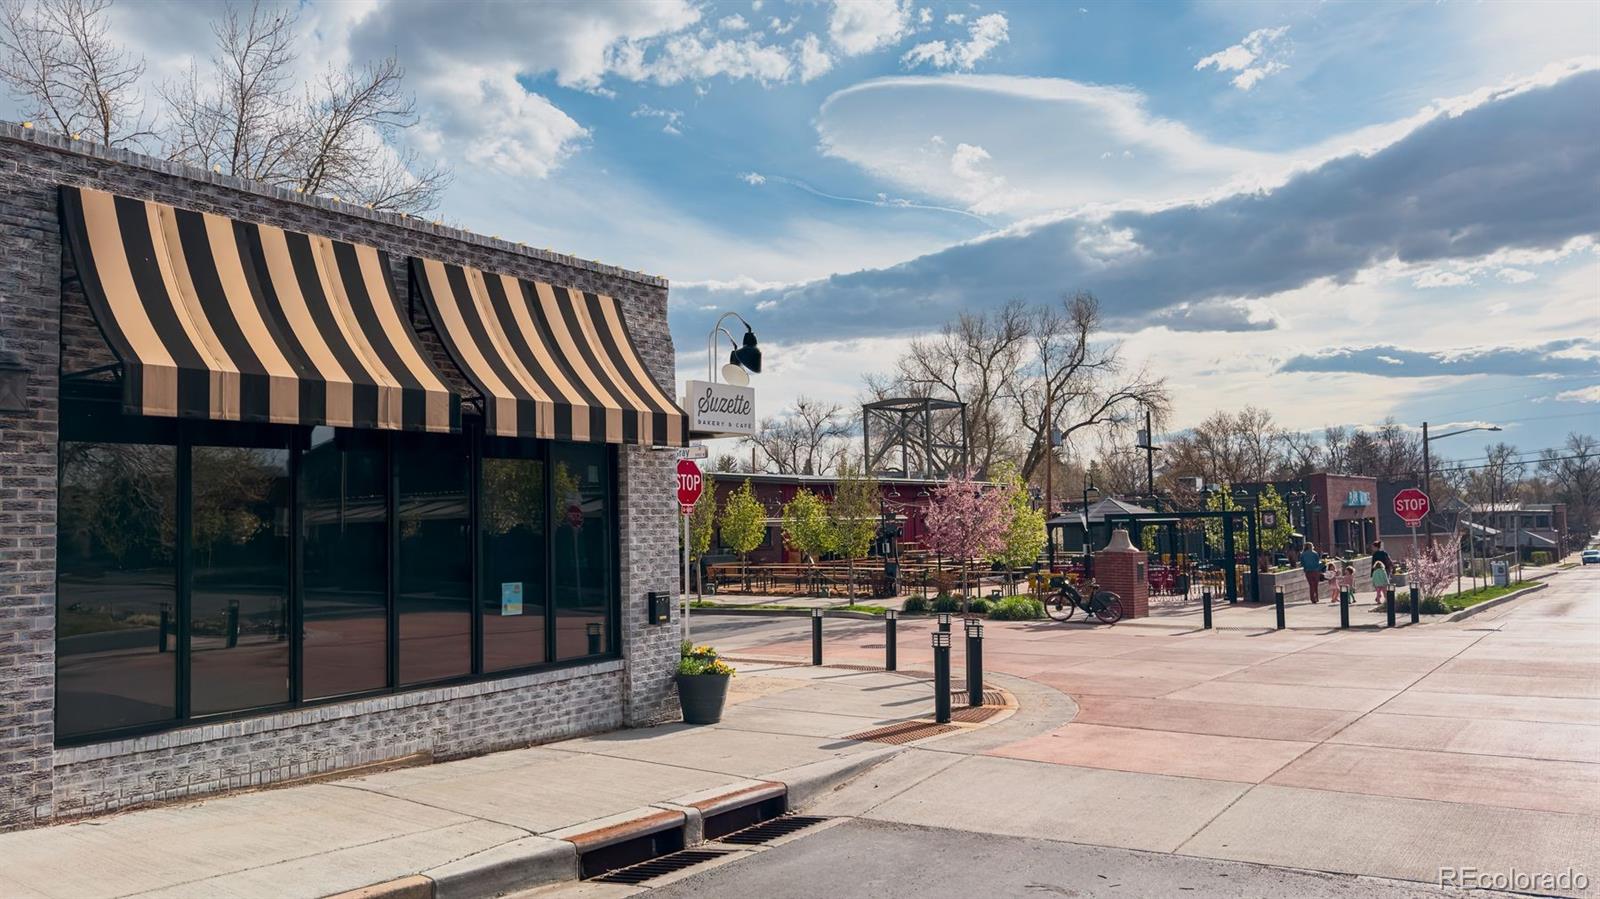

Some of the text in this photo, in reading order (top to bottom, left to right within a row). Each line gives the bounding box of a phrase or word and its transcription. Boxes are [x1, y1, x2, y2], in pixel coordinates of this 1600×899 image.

[698, 387, 751, 416] Suzette
[698, 419, 724, 427] BAKERY
[677, 474, 700, 491] STOP
[1396, 499, 1426, 511] STOP
